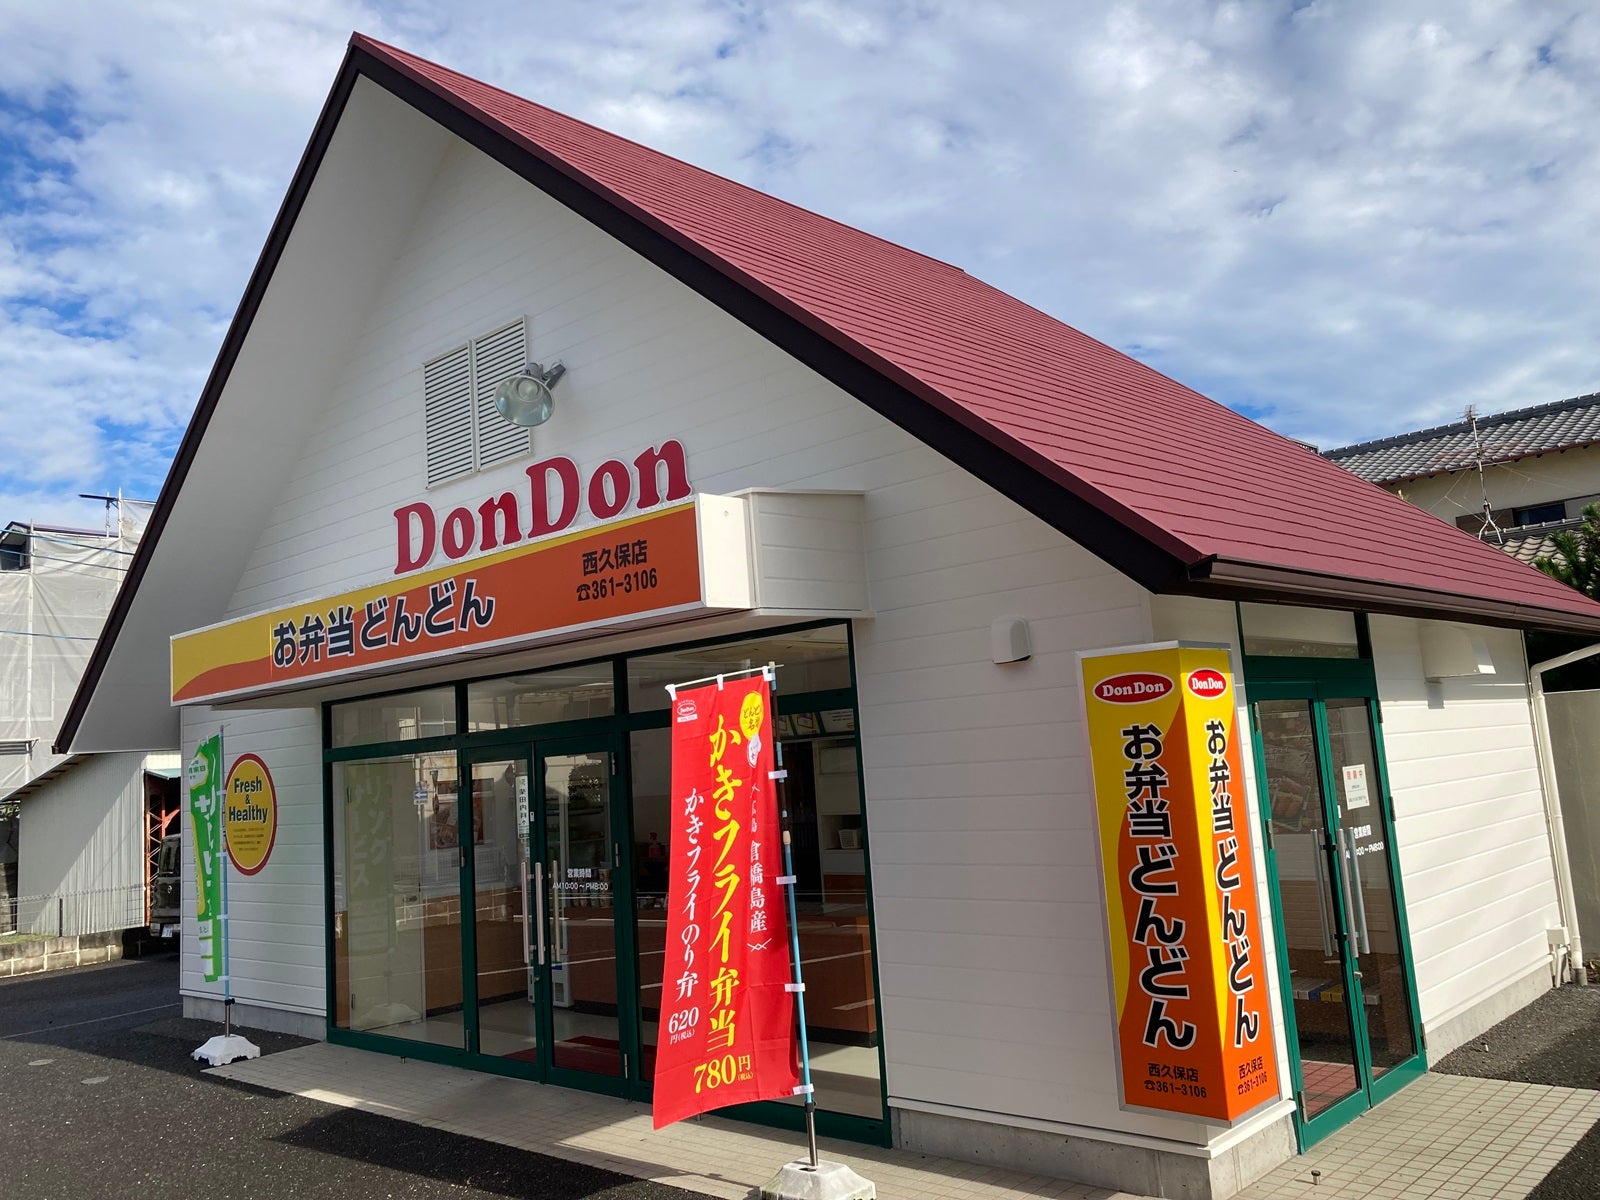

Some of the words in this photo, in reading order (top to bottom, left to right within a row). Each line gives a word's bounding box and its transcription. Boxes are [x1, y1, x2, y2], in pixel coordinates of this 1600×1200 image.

[393, 438, 692, 575] DonDon
[582, 540, 647, 576] 西久保店
[273, 578, 495, 667] お弁当どんどん
[234, 776, 262, 793] Fresh
[245, 794, 251, 805] &
[228, 804, 268, 824] Healthy
[567, 868, 591, 878] 営業時間
[707, 714, 742, 1052] かきフライ弁当
[1120, 721, 1197, 1049] お弁当どんどん
[1205, 718, 1259, 1048] お弁当どんどん
[675, 788, 704, 1002] かきフライのり弁
[668, 1006, 699, 1034] 620
[694, 1054, 737, 1094] 780
[738, 1055, 751, 1072] 円
[1148, 1063, 1198, 1082] 西久保店
[1238, 1056, 1263, 1079] 西久保店
